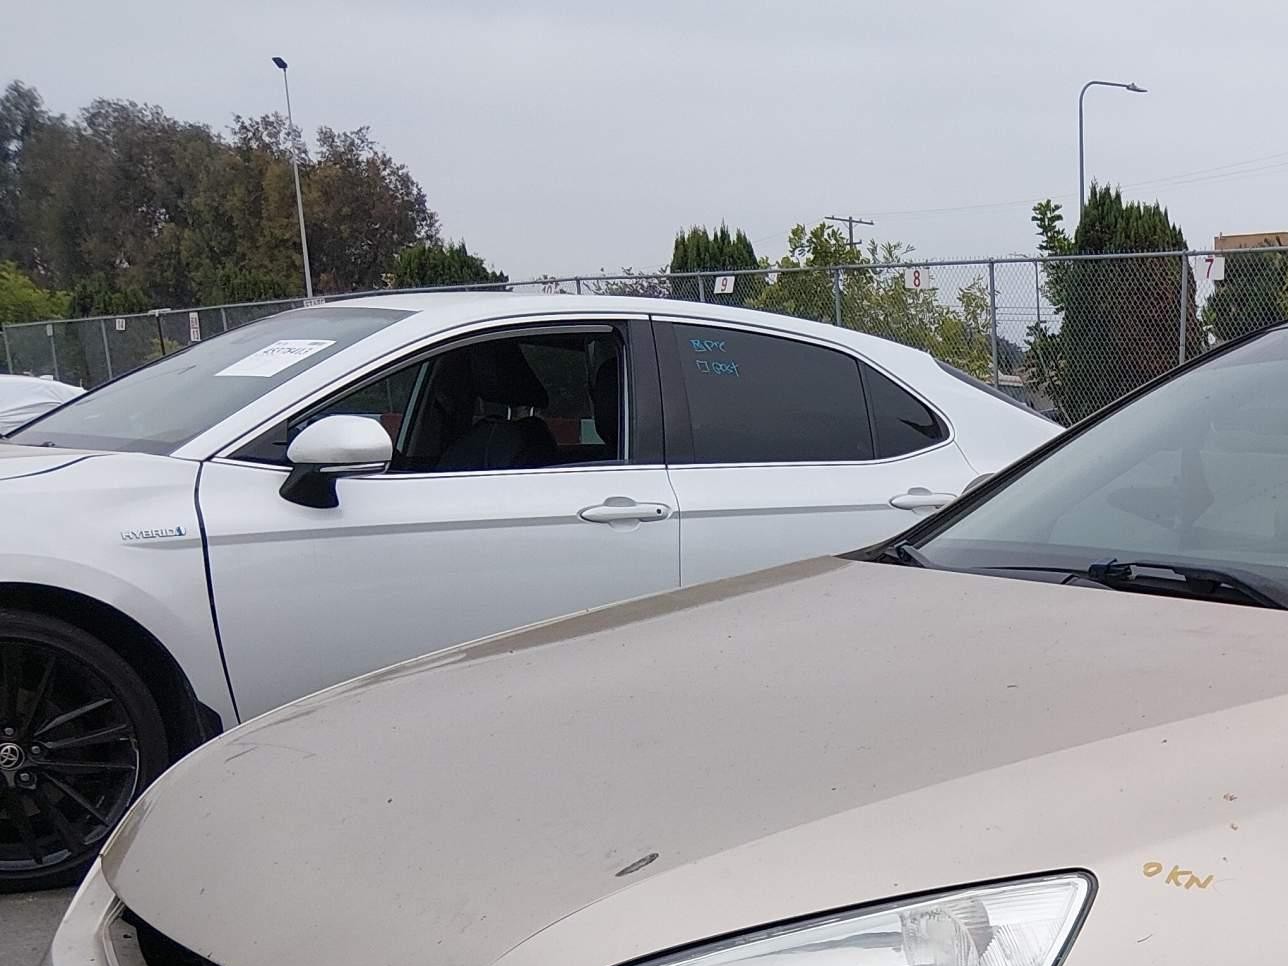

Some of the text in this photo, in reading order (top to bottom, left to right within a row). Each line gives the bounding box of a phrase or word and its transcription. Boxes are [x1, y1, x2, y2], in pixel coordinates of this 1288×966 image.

[1204, 257, 1215, 279] 7
[720, 276, 728, 291] 9
[912, 269, 921, 287] 8
[120, 528, 175, 541] HYBRID
